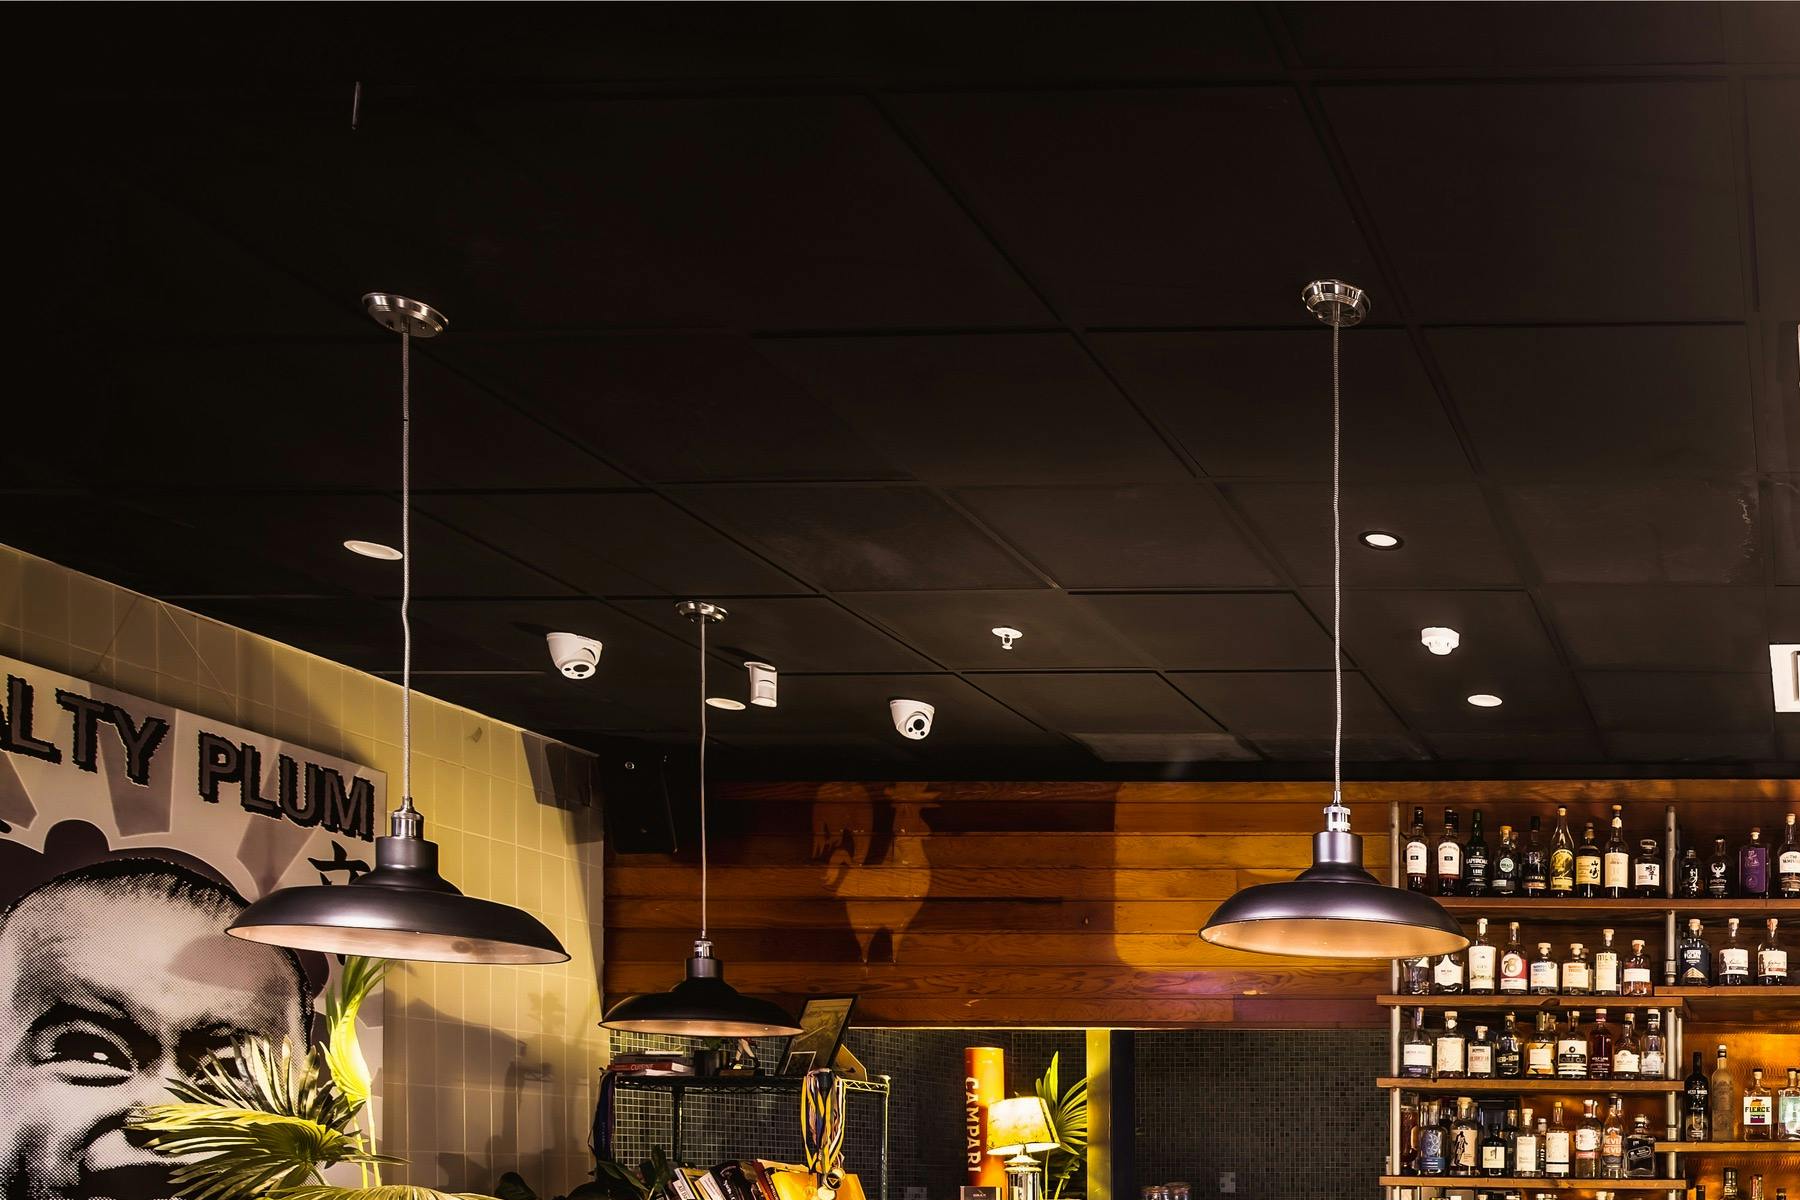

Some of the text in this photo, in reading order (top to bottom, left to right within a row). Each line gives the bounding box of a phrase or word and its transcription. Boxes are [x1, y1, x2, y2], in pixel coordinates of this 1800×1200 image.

[0, 673, 374, 842] LTY PLUM
[965, 1077, 982, 1173] CAMPARI
